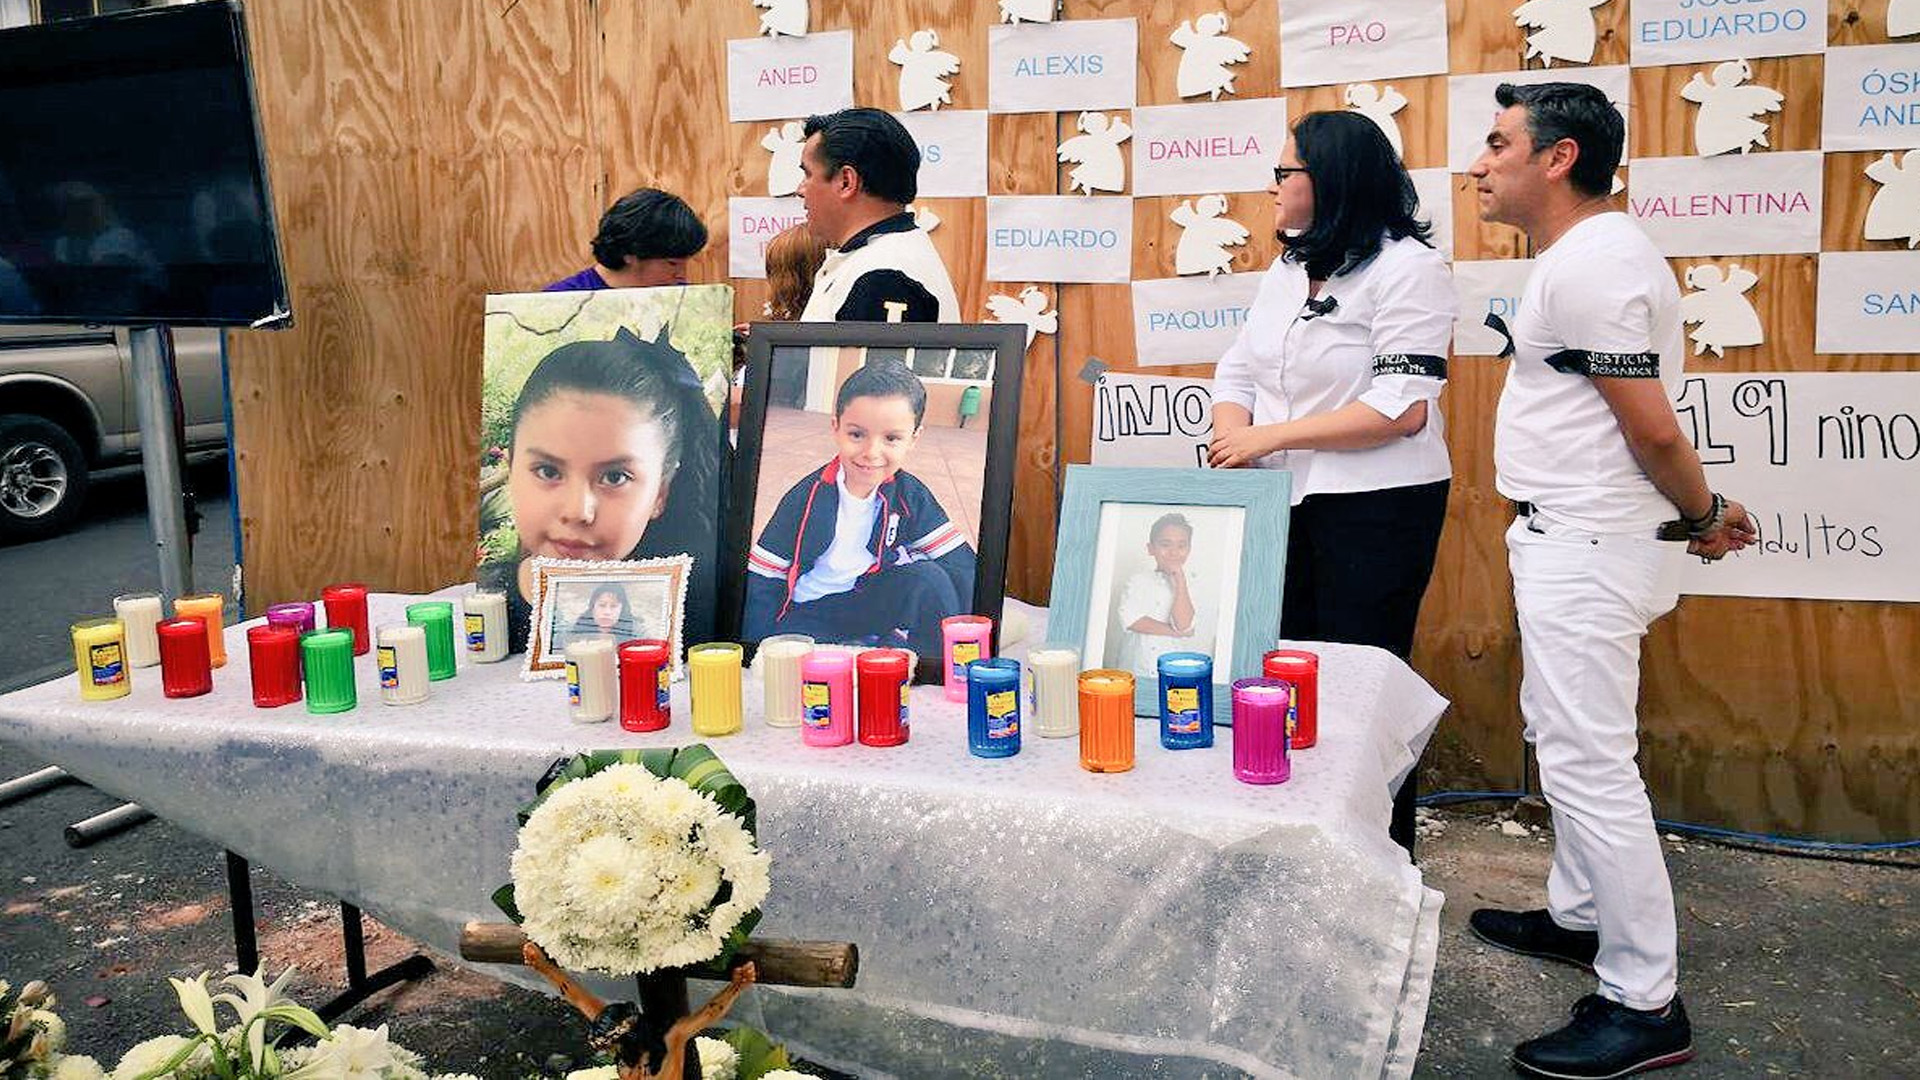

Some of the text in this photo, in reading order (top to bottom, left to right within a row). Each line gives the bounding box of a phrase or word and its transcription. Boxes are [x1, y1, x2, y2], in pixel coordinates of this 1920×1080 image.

[1330, 23, 1386, 46] PAO
[1642, 9, 1807, 43] EDUARDO
[757, 65, 818, 87] ANED
[1015, 55, 1103, 77] ALEXIS
[1149, 136, 1261, 161] DANIELA
[1631, 192, 1810, 218] VALENTINA
[995, 228, 1117, 249] EDUARDO
[1587, 352, 1651, 365] JUSTICIA
[1676, 378, 1788, 466] 19
